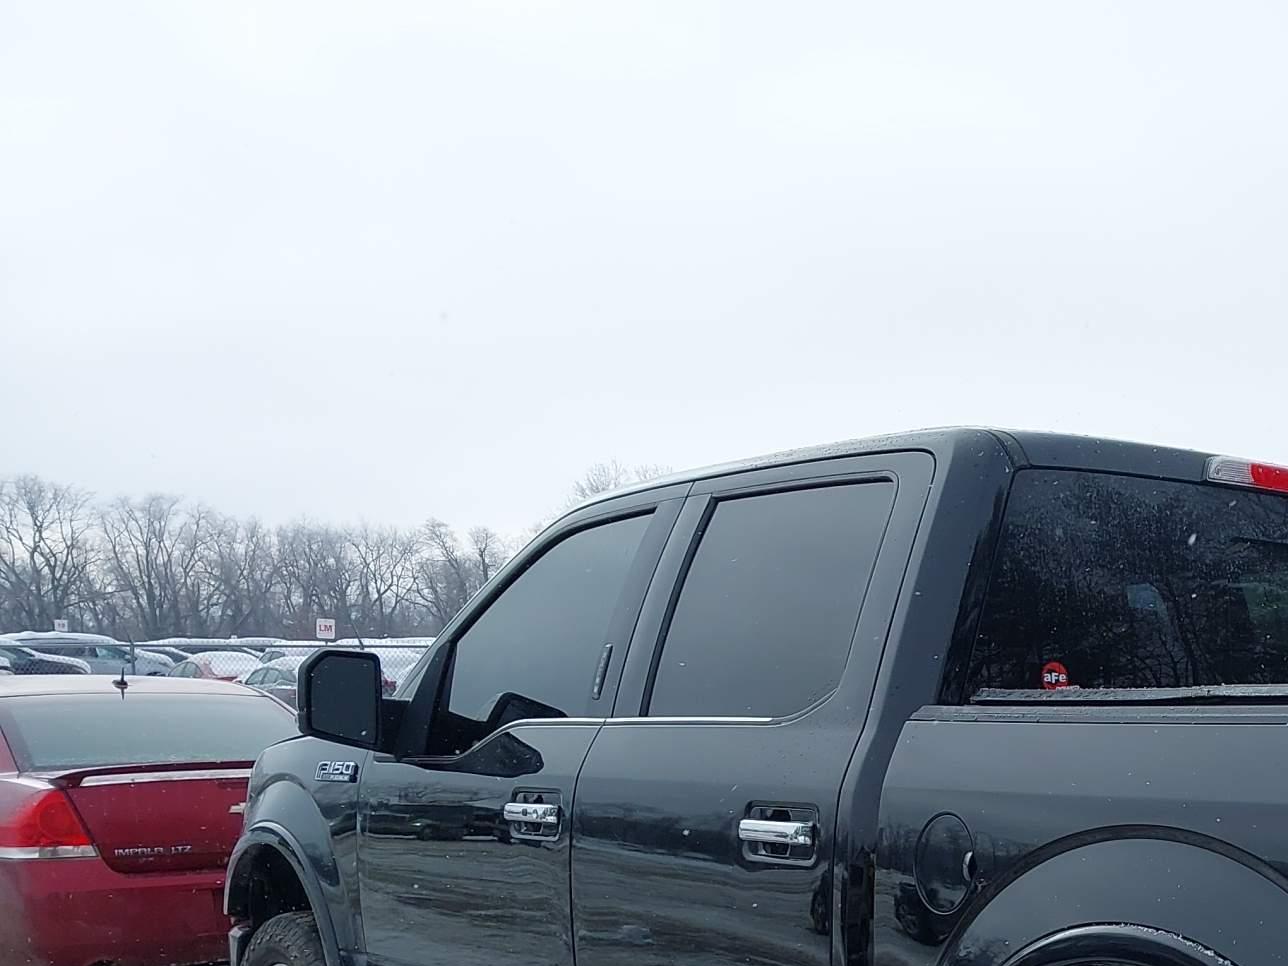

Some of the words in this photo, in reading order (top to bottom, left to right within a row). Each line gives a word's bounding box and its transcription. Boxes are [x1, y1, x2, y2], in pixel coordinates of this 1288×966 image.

[318, 624, 333, 632] LM
[1043, 672, 1067, 683] aFe
[114, 847, 164, 857] IMPALA
[171, 845, 192, 855] LTZ
